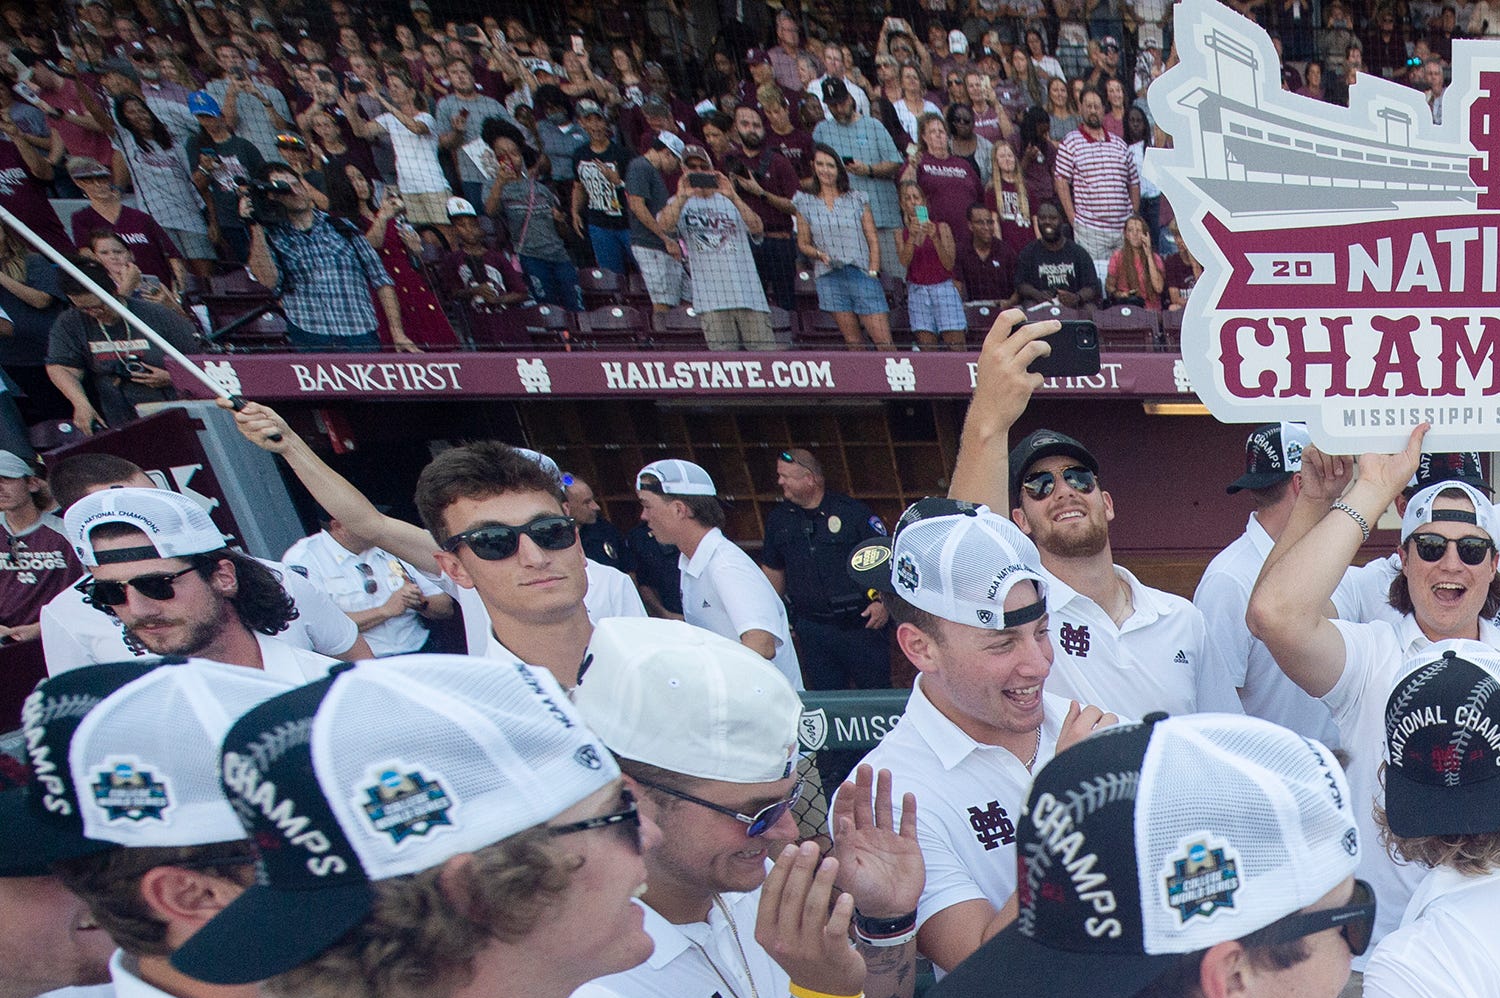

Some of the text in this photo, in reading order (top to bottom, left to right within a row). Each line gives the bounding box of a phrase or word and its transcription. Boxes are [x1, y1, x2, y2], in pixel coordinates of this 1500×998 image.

[1272, 260, 1312, 277] 20
[292, 363, 462, 391] BANKFIRST
[601, 361, 837, 389] HAILSTATE.COM
[1343, 407, 1484, 427] MISSISSIPPI
[1253, 433, 1281, 469] CHAMPS
[87, 511, 117, 526] NATIONAL
[118, 510, 160, 535] CHAMPIONS
[1391, 705, 1448, 768] NATIONAL
[223, 752, 348, 877] CHAMPS
[1033, 792, 1122, 939] CHAMPS
